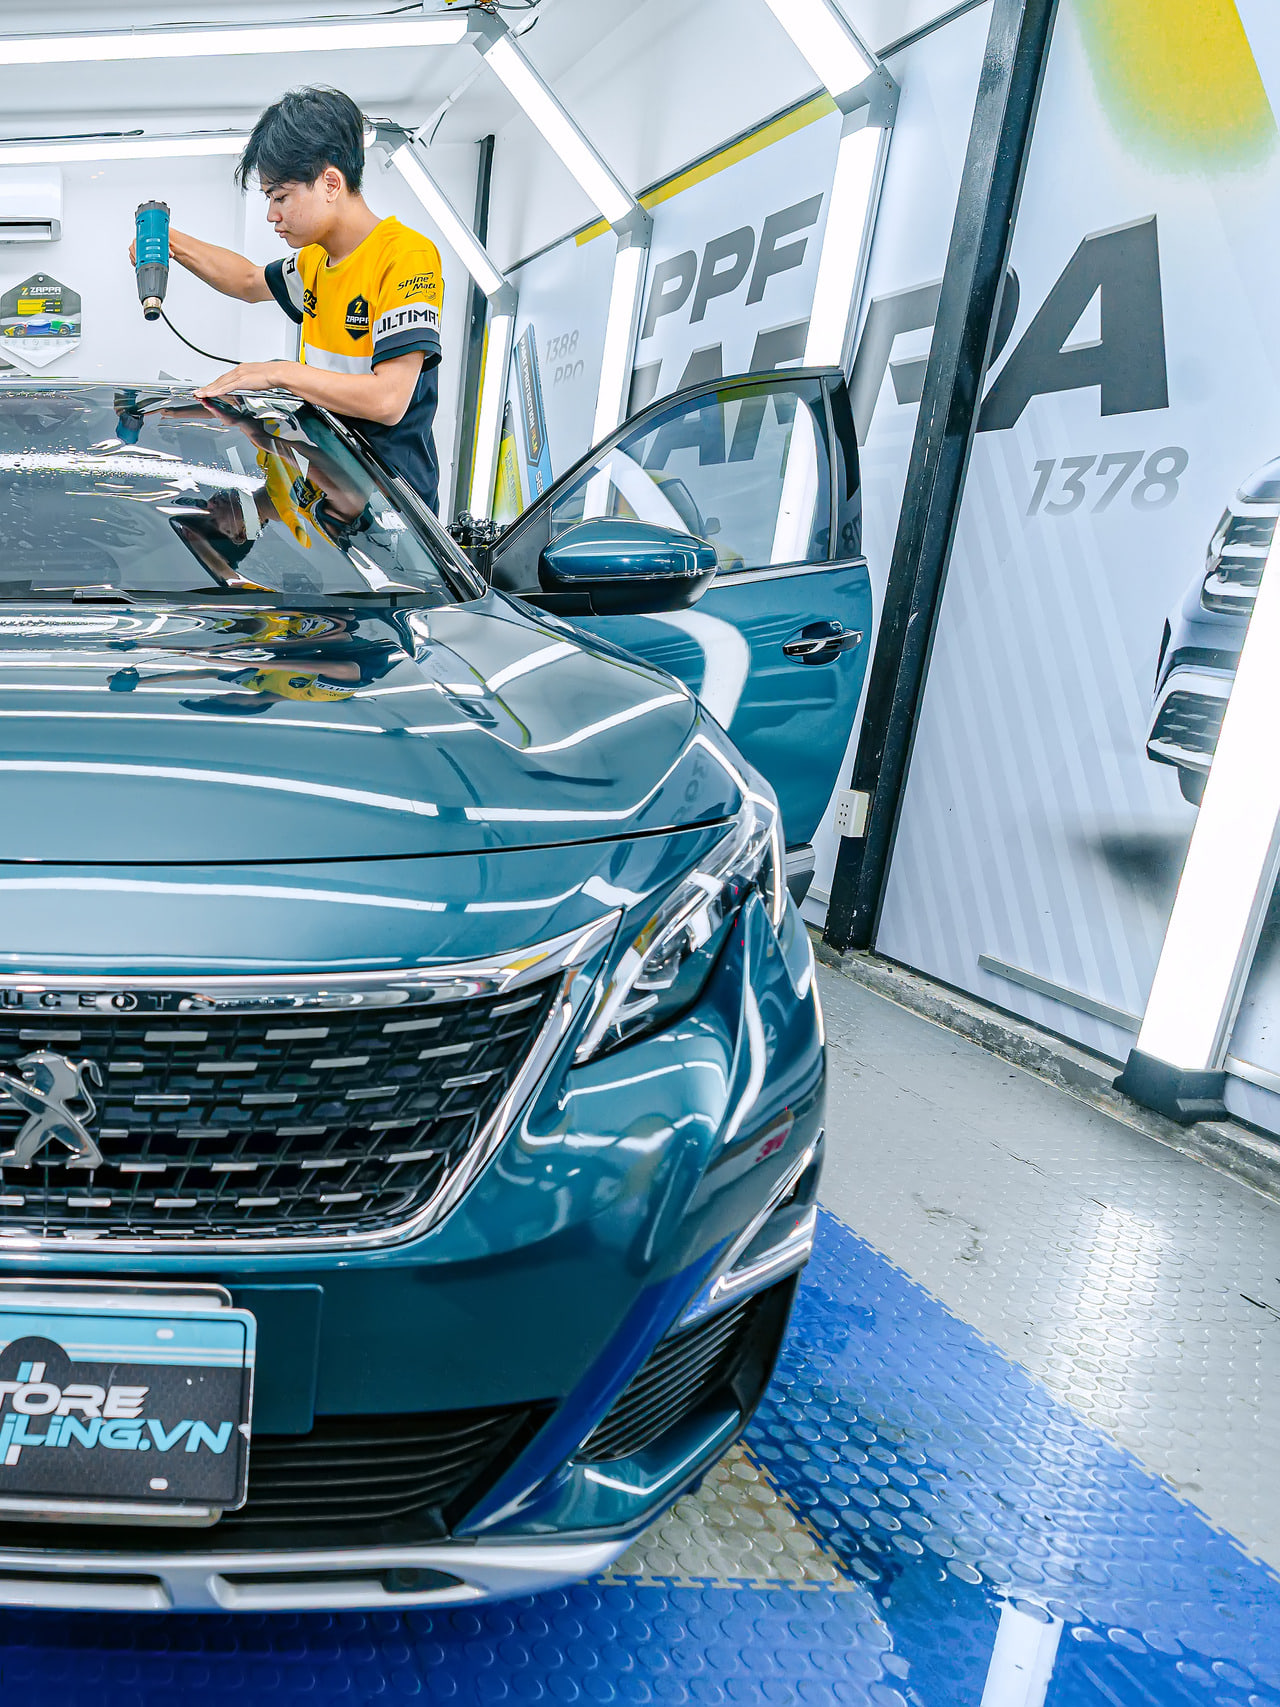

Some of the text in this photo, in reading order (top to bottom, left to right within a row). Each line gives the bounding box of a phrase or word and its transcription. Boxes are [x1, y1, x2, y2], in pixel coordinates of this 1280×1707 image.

[396, 276, 429, 291] Shine
[640, 192, 824, 340] PPF
[376, 308, 439, 335] ULTIMA
[545, 329, 579, 364] 1388
[523, 365, 535, 430] PROTECTION
[1025, 446, 1189, 517] 1378
